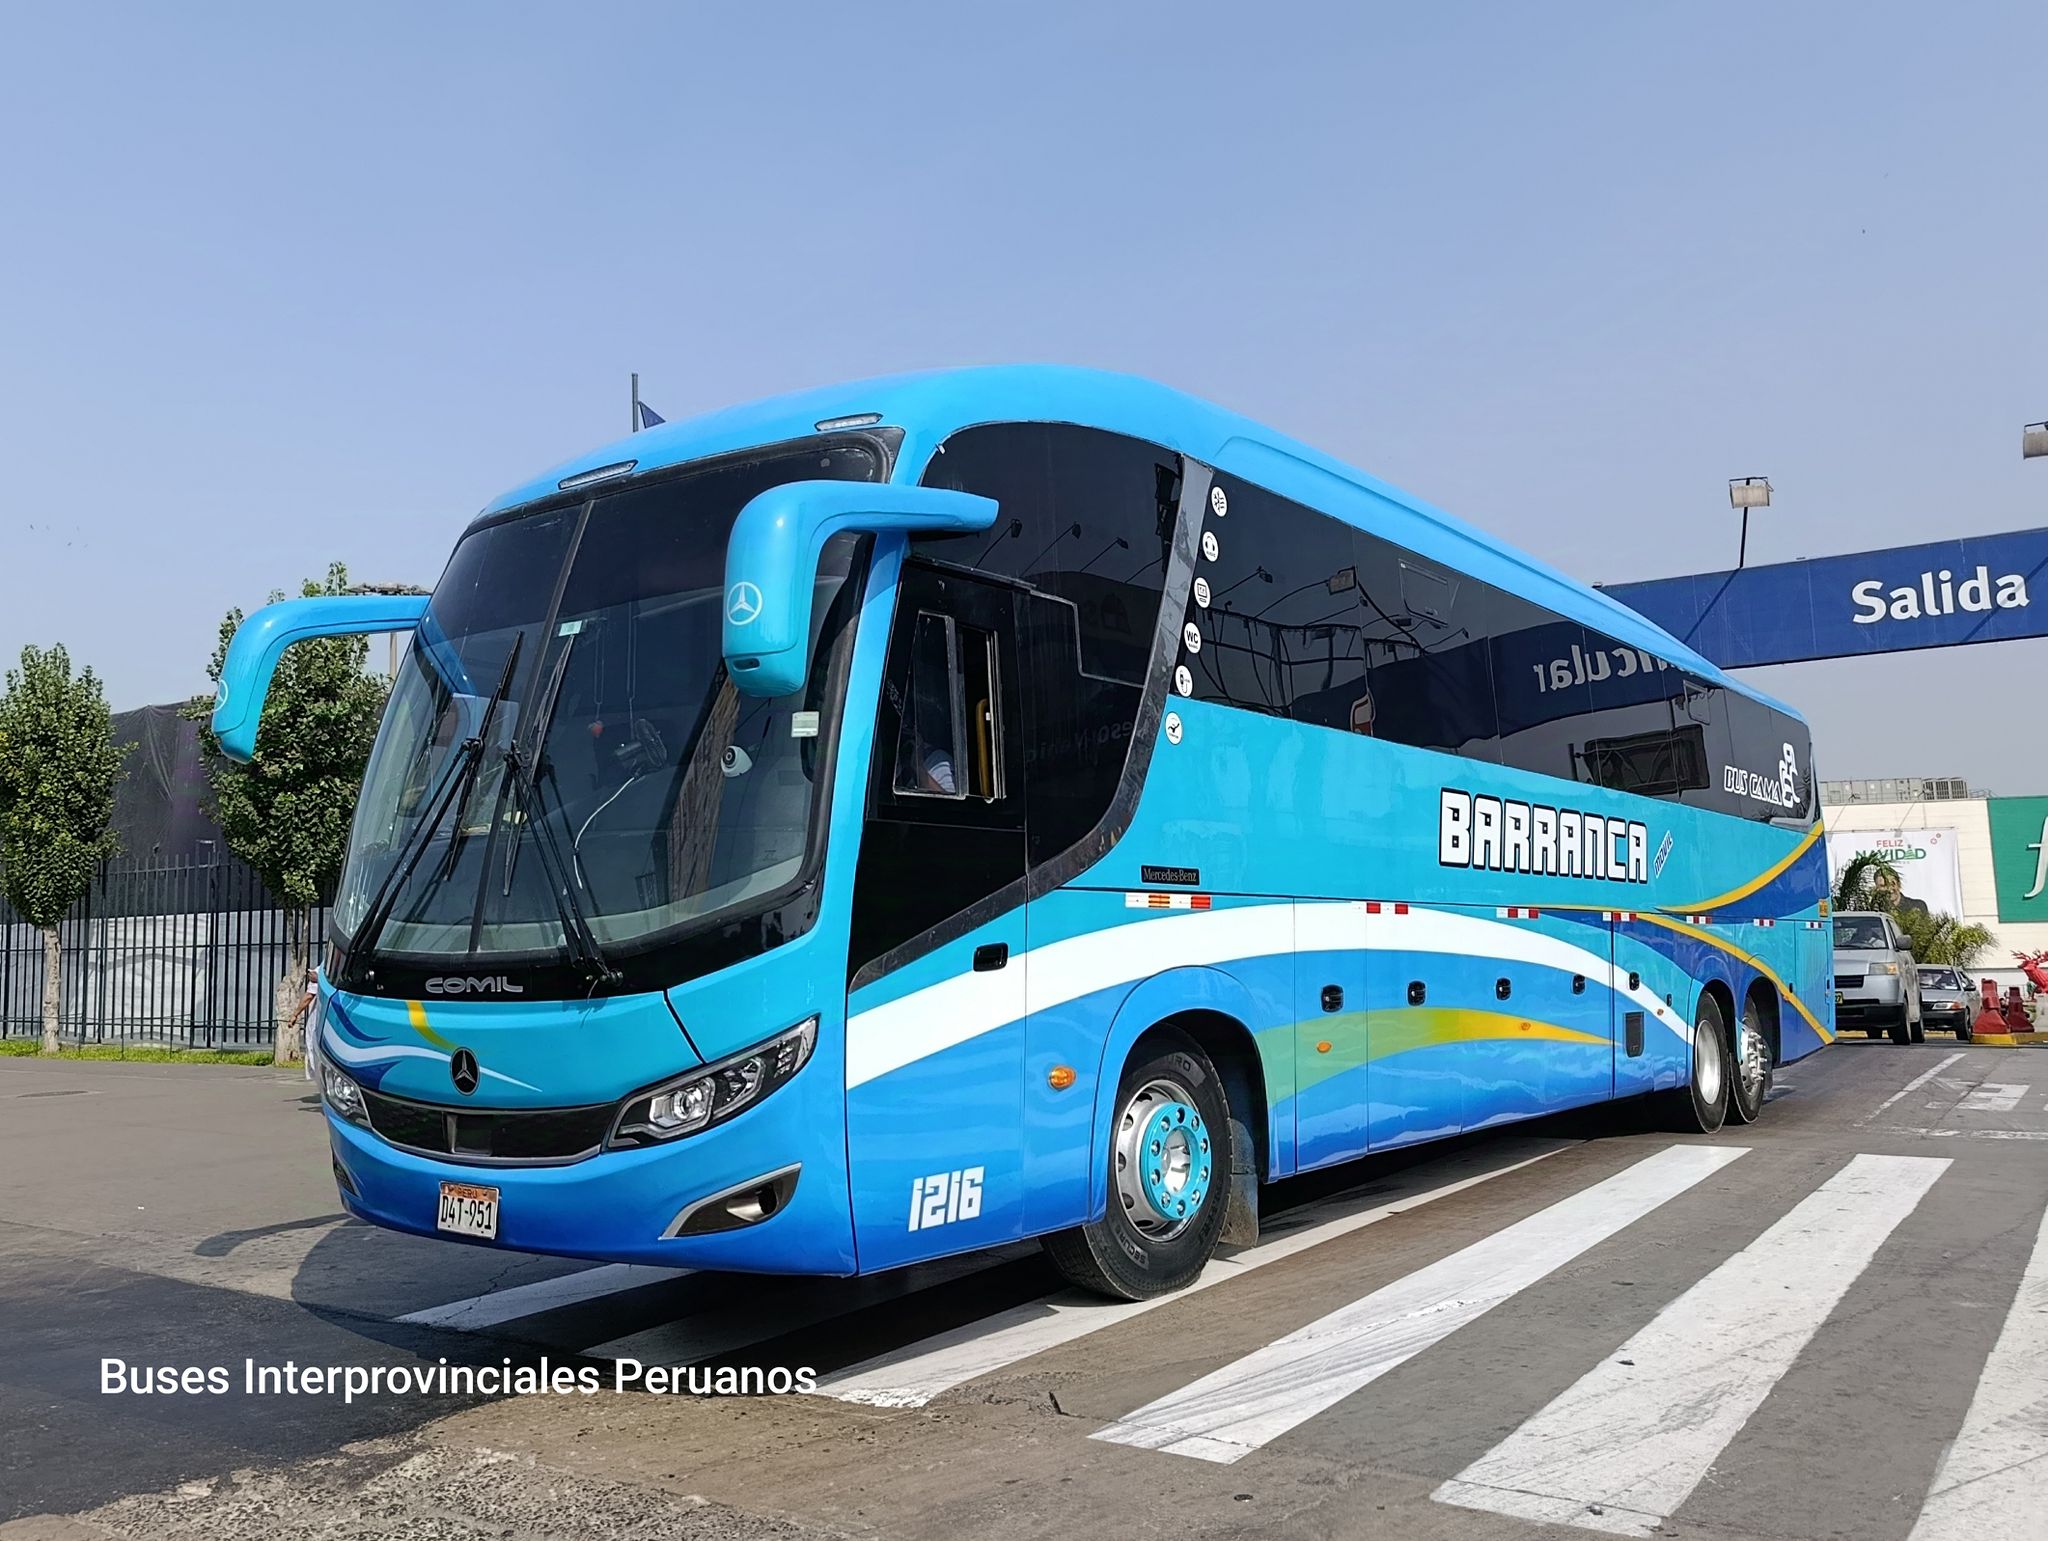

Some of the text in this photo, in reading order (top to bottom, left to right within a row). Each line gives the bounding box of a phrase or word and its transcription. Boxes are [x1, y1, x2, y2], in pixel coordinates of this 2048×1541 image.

[1851, 565, 2030, 624] Salida
[1186, 630, 1199, 644] WC
[1724, 765, 1783, 806] BUS CAMA
[1439, 787, 1648, 884] BARRANCA
[1876, 839, 1904, 848] FELIZ
[1143, 867, 1197, 882] Mercedes-Benz
[425, 976, 523, 993] COMIL
[441, 1195, 492, 1230] D4T-951
[908, 1166, 985, 1232] 1216
